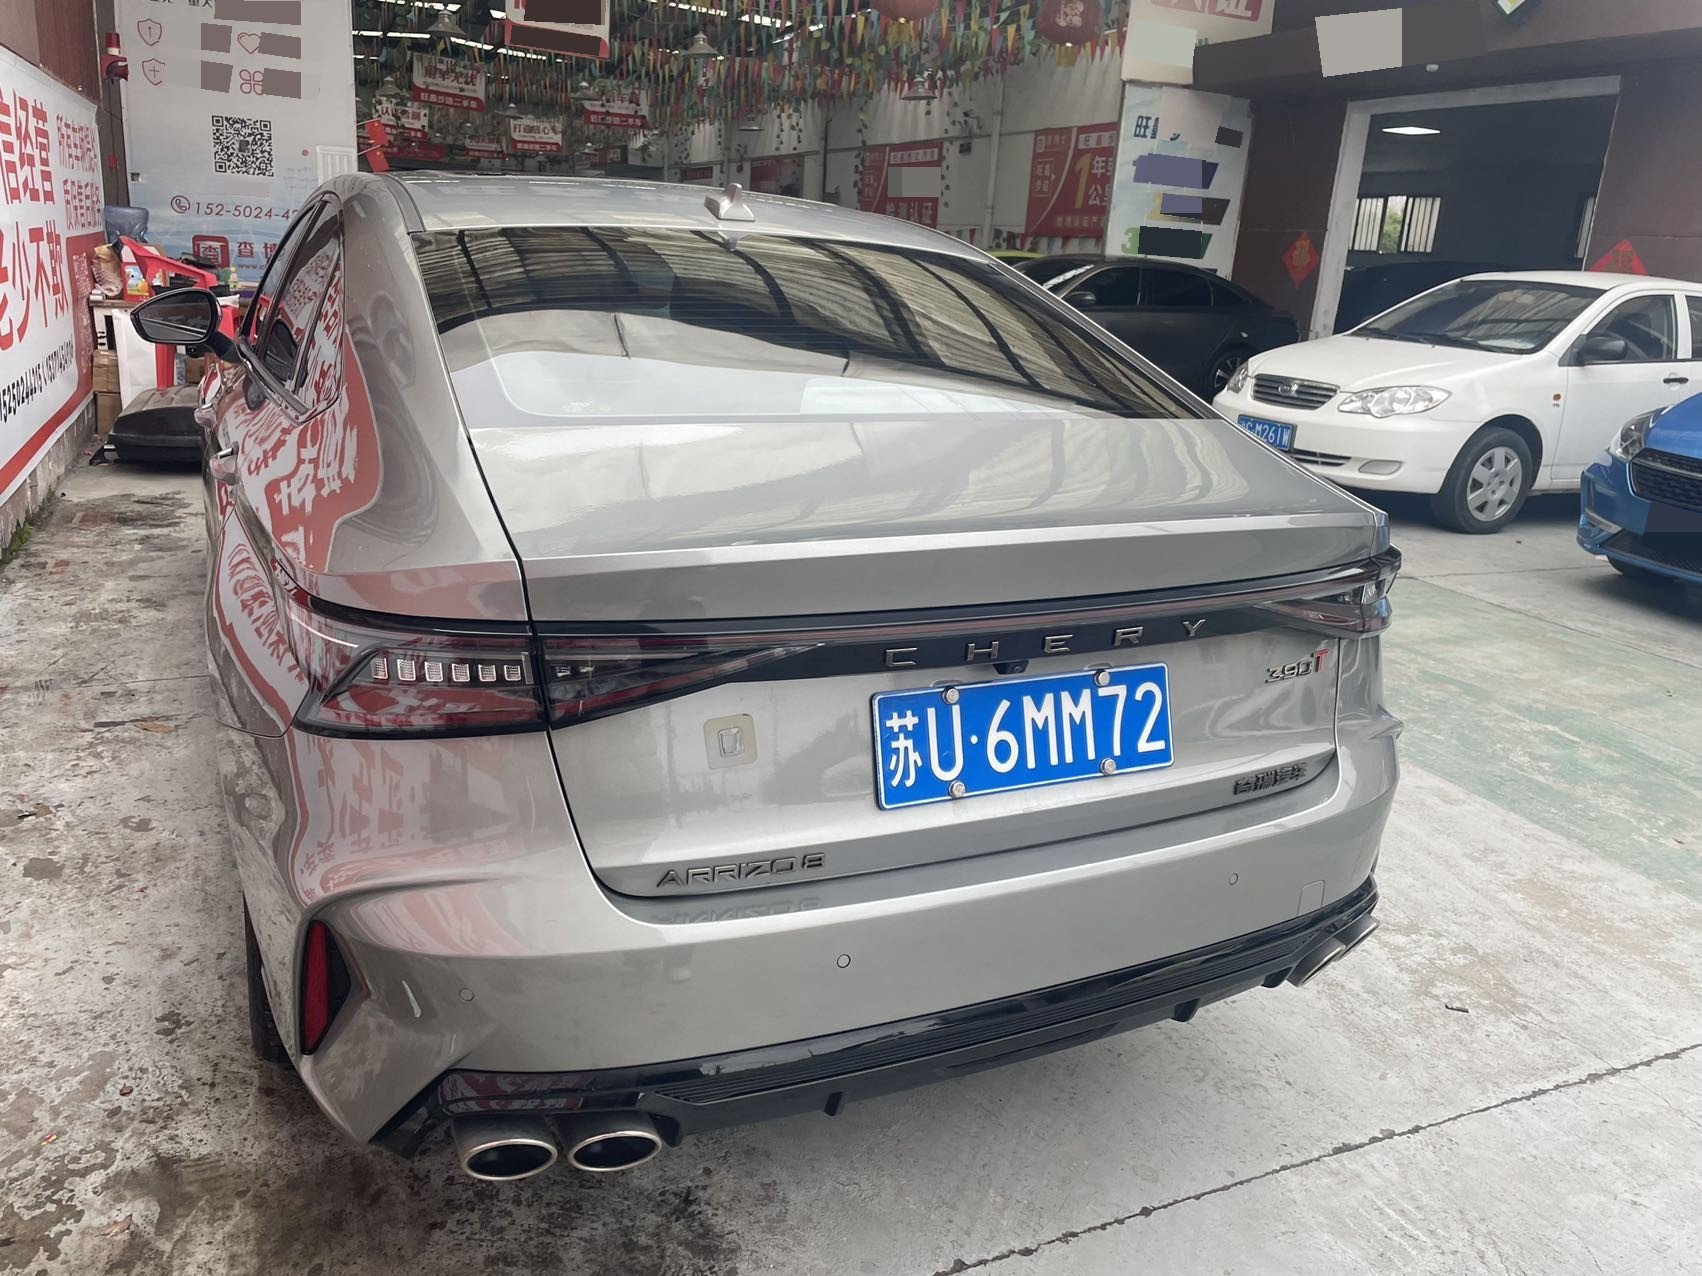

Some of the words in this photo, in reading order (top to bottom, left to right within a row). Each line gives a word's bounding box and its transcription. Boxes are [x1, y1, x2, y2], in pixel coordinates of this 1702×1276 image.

[195, 202, 299, 220] 152-5024-4
[884, 618, 1207, 667] CHERY
[1265, 649, 1329, 683] 390T
[885, 681, 1166, 788] 苏U·6MM72
[1233, 761, 1309, 796] 奇瑞汽车
[656, 855, 797, 888] ARRIZO
